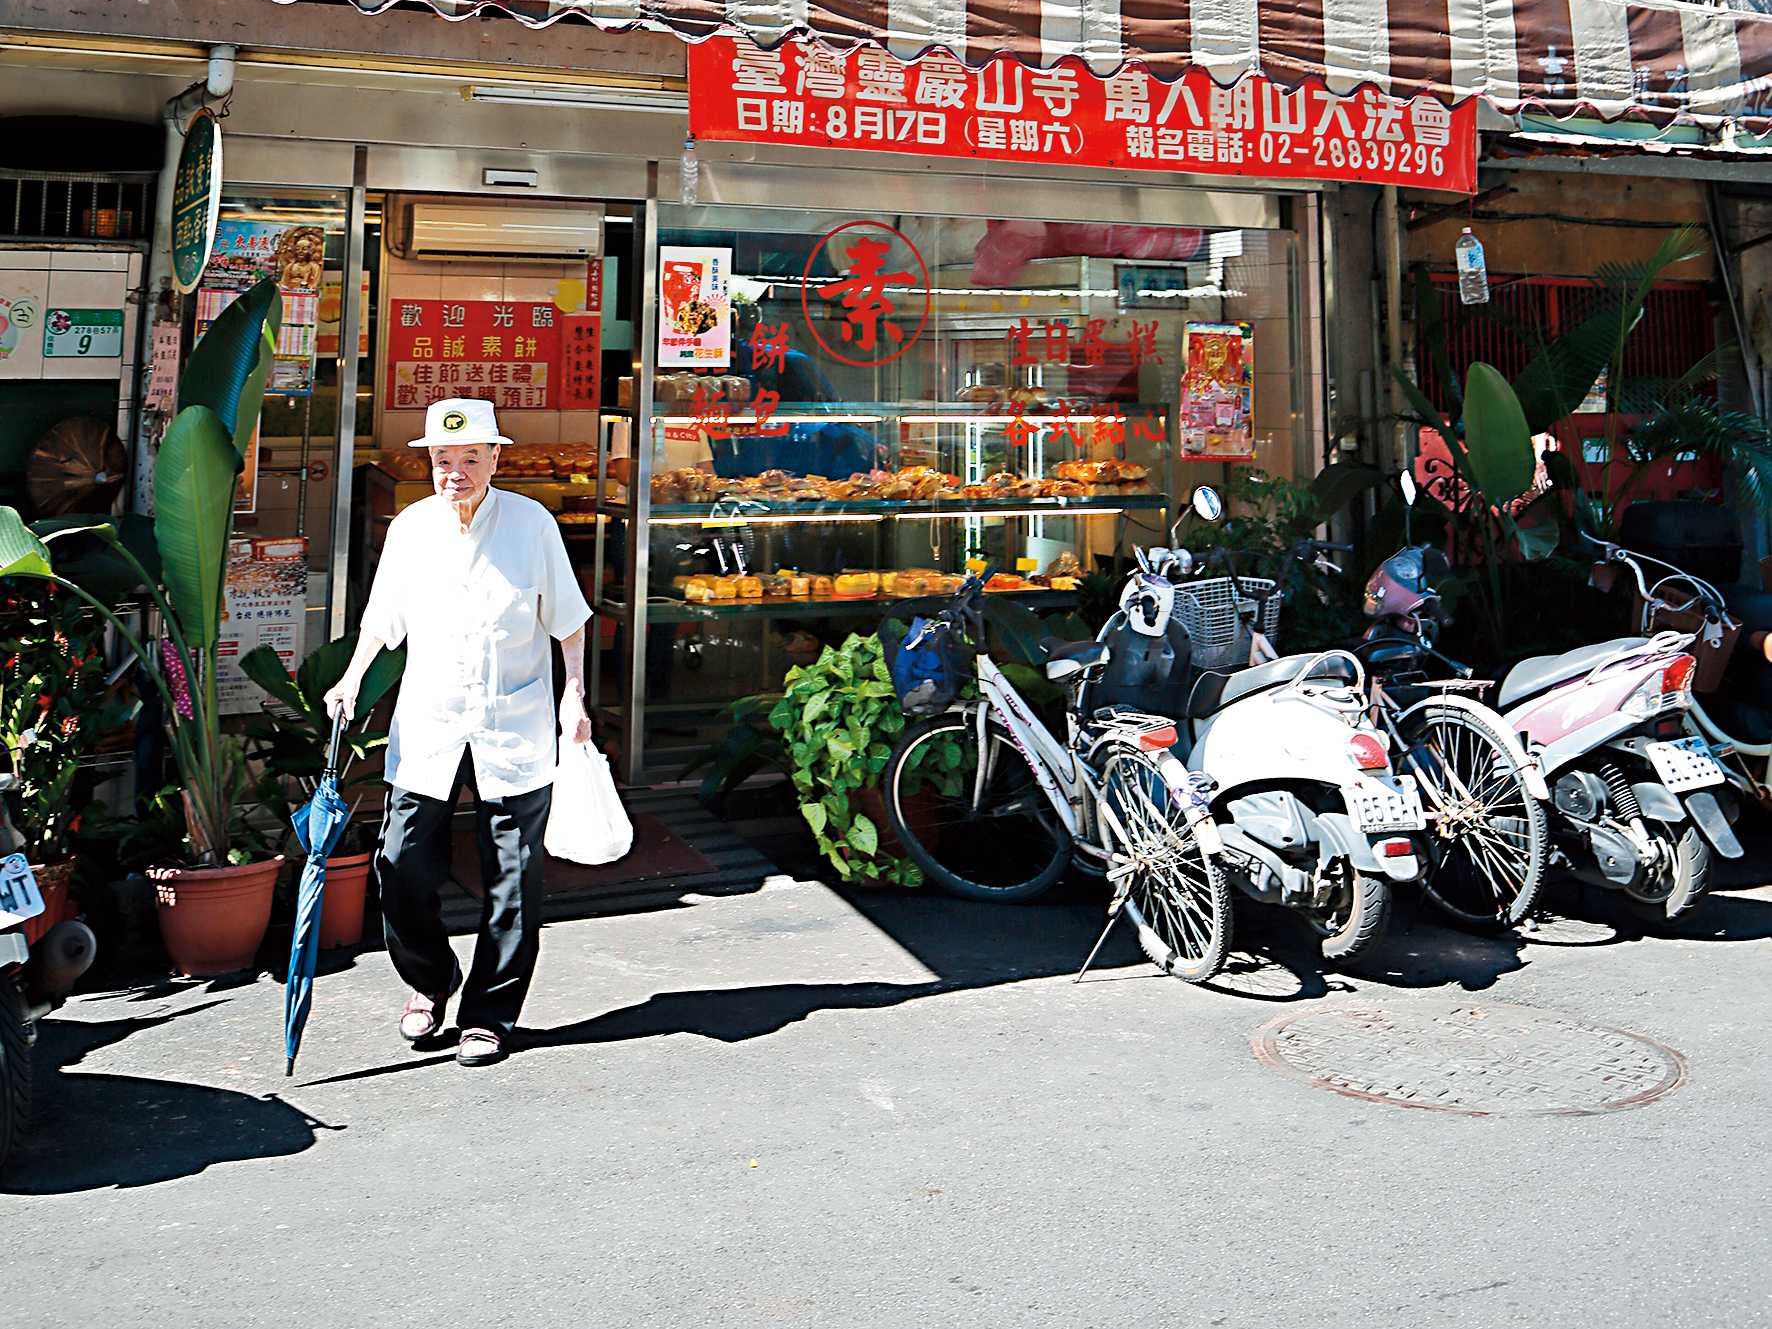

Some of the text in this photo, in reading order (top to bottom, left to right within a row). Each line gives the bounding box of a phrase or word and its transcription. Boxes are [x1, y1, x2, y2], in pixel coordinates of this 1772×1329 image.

[817, 236, 919, 353] 素
[401, 304, 554, 328] 歡迎光臨
[77, 334, 92, 355] 9
[413, 335, 537, 358] 品誠素餅
[1006, 318, 1163, 368] 生日蛋糕
[412, 363, 533, 384] 佳節送佳禮
[688, 386, 790, 441] 麵包
[1000, 398, 1167, 448] 各式點心
